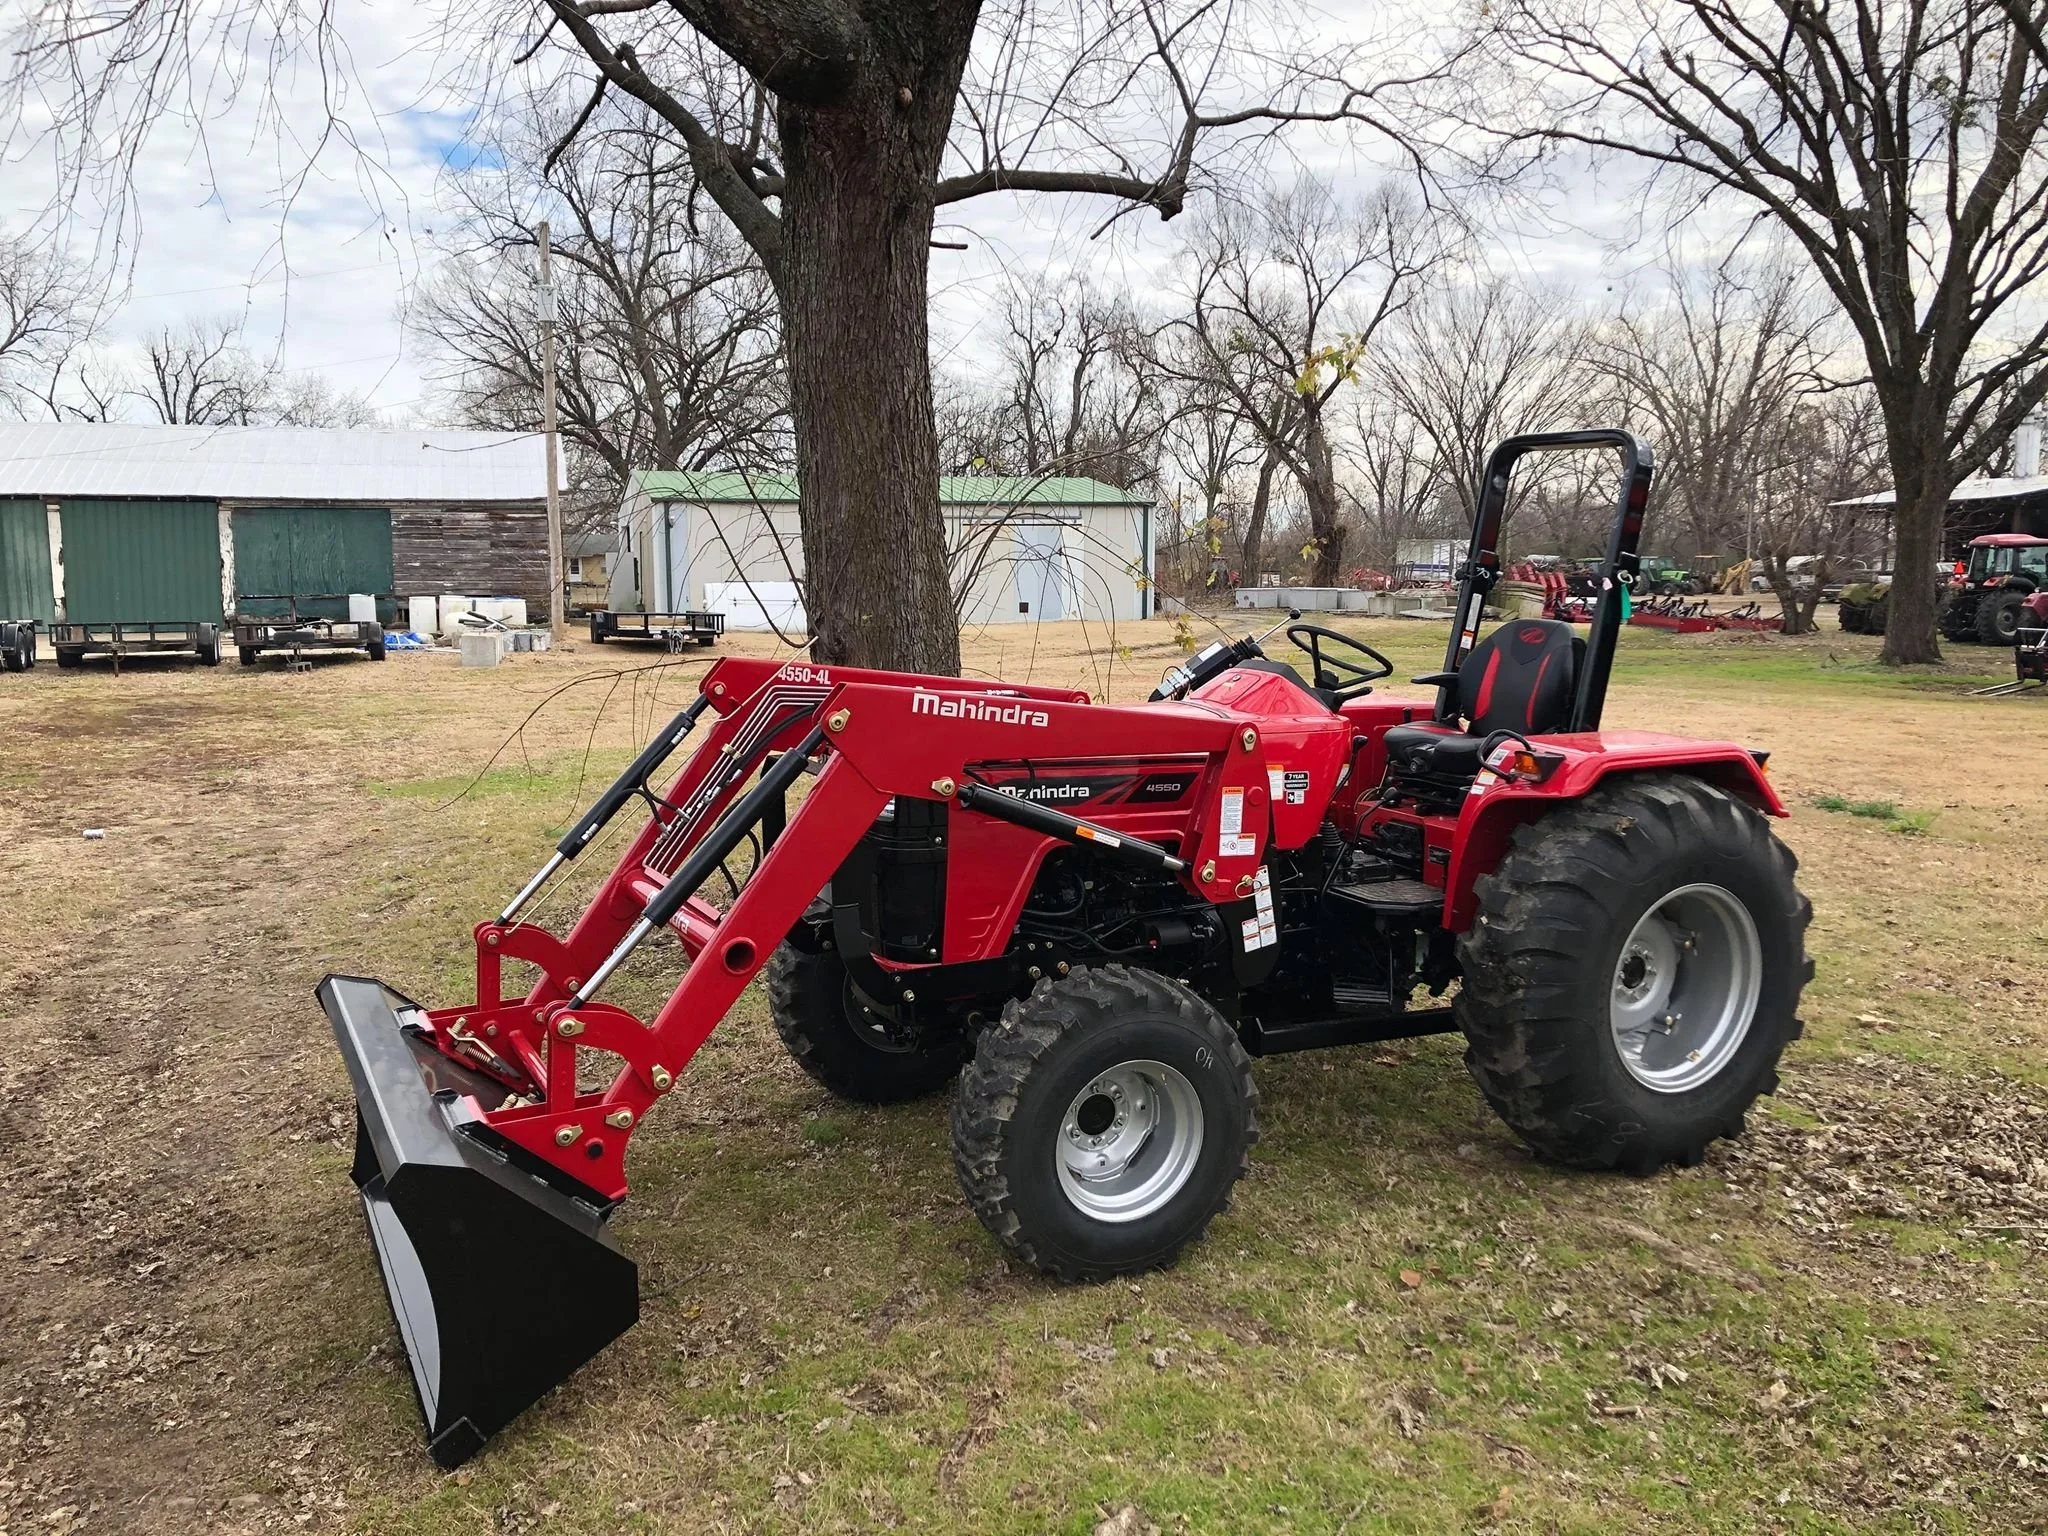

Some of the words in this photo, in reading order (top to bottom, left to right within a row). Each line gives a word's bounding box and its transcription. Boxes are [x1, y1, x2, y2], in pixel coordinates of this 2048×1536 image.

[778, 666, 831, 685] 4550-4L
[912, 692, 1049, 727] Mahindra
[1146, 784, 1181, 792] 4550
